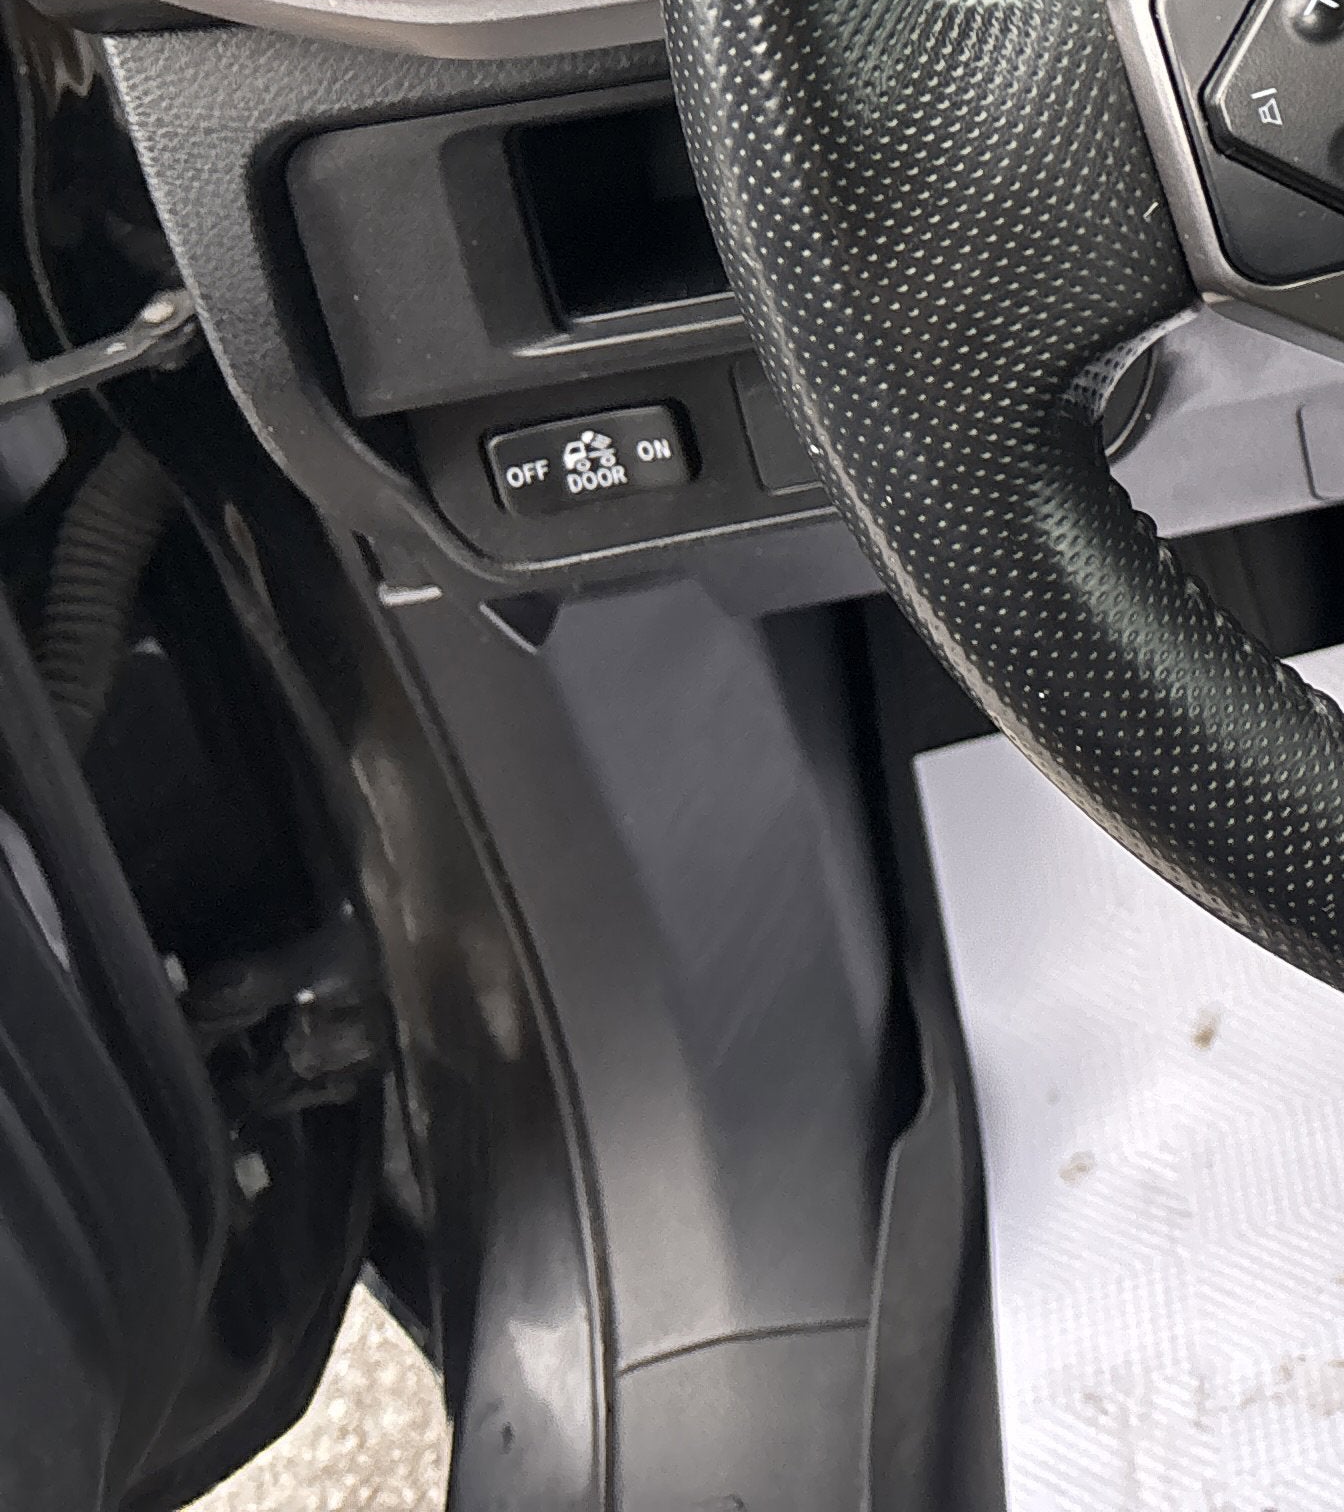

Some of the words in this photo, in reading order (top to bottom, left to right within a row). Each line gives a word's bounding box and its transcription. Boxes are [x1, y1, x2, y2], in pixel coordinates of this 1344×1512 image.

[636, 439, 672, 462] ON
[506, 459, 549, 489] OFF
[567, 464, 628, 494] DOOR
